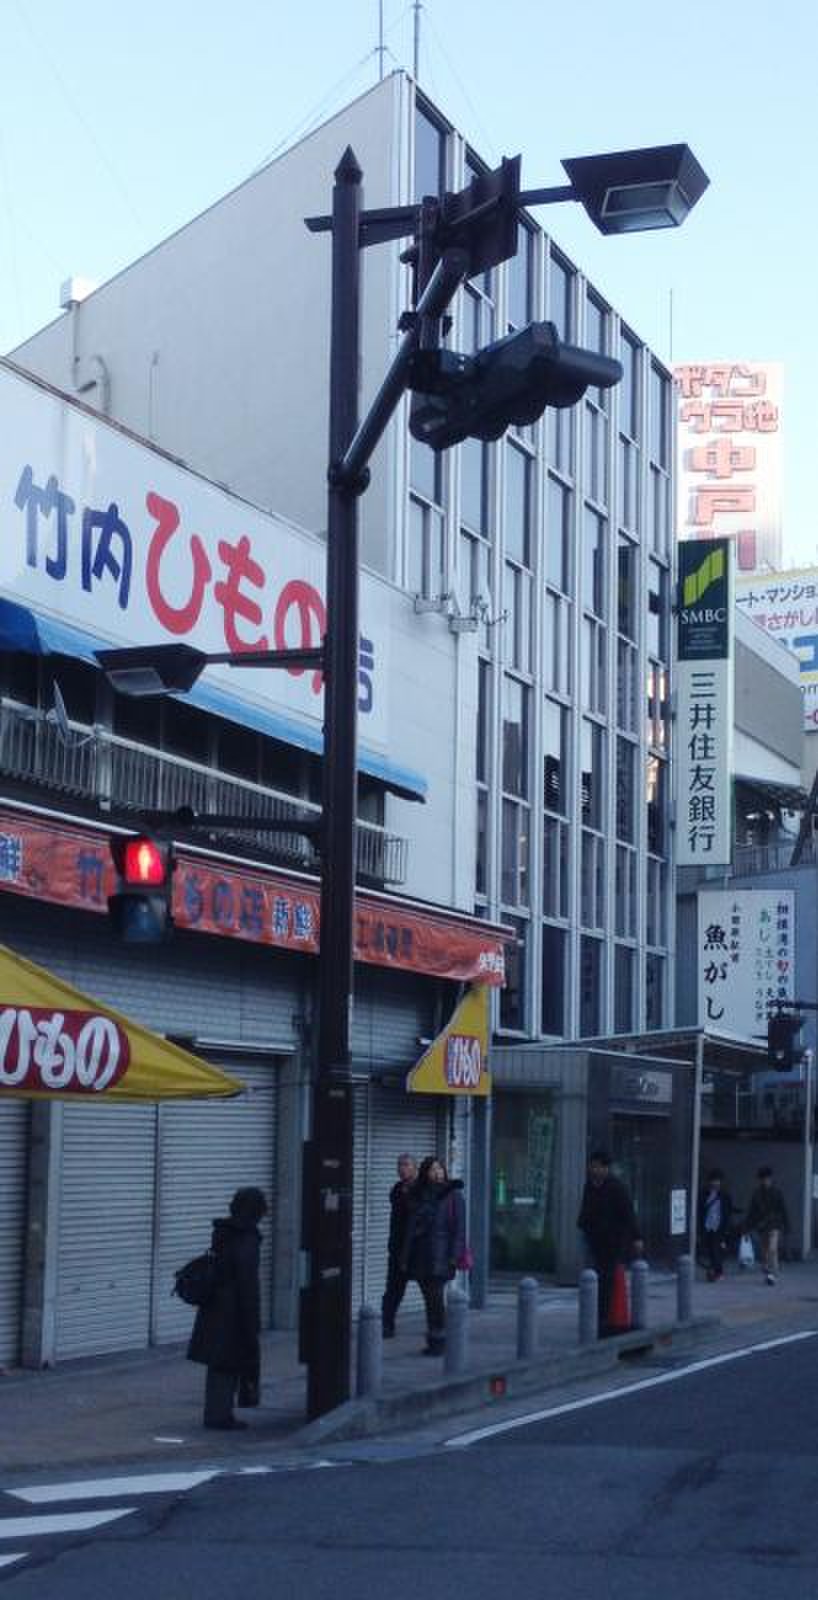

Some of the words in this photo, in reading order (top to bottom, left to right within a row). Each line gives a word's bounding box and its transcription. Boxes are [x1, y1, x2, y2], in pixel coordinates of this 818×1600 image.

[675, 364, 767, 398] ボタン
[680, 400, 778, 432] ウラ地
[680, 608, 726, 625] SMBC
[688, 672, 717, 854] 三井住友銀行
[703, 924, 729, 1020] 魚がし
[0, 1008, 121, 1091] ひもの
